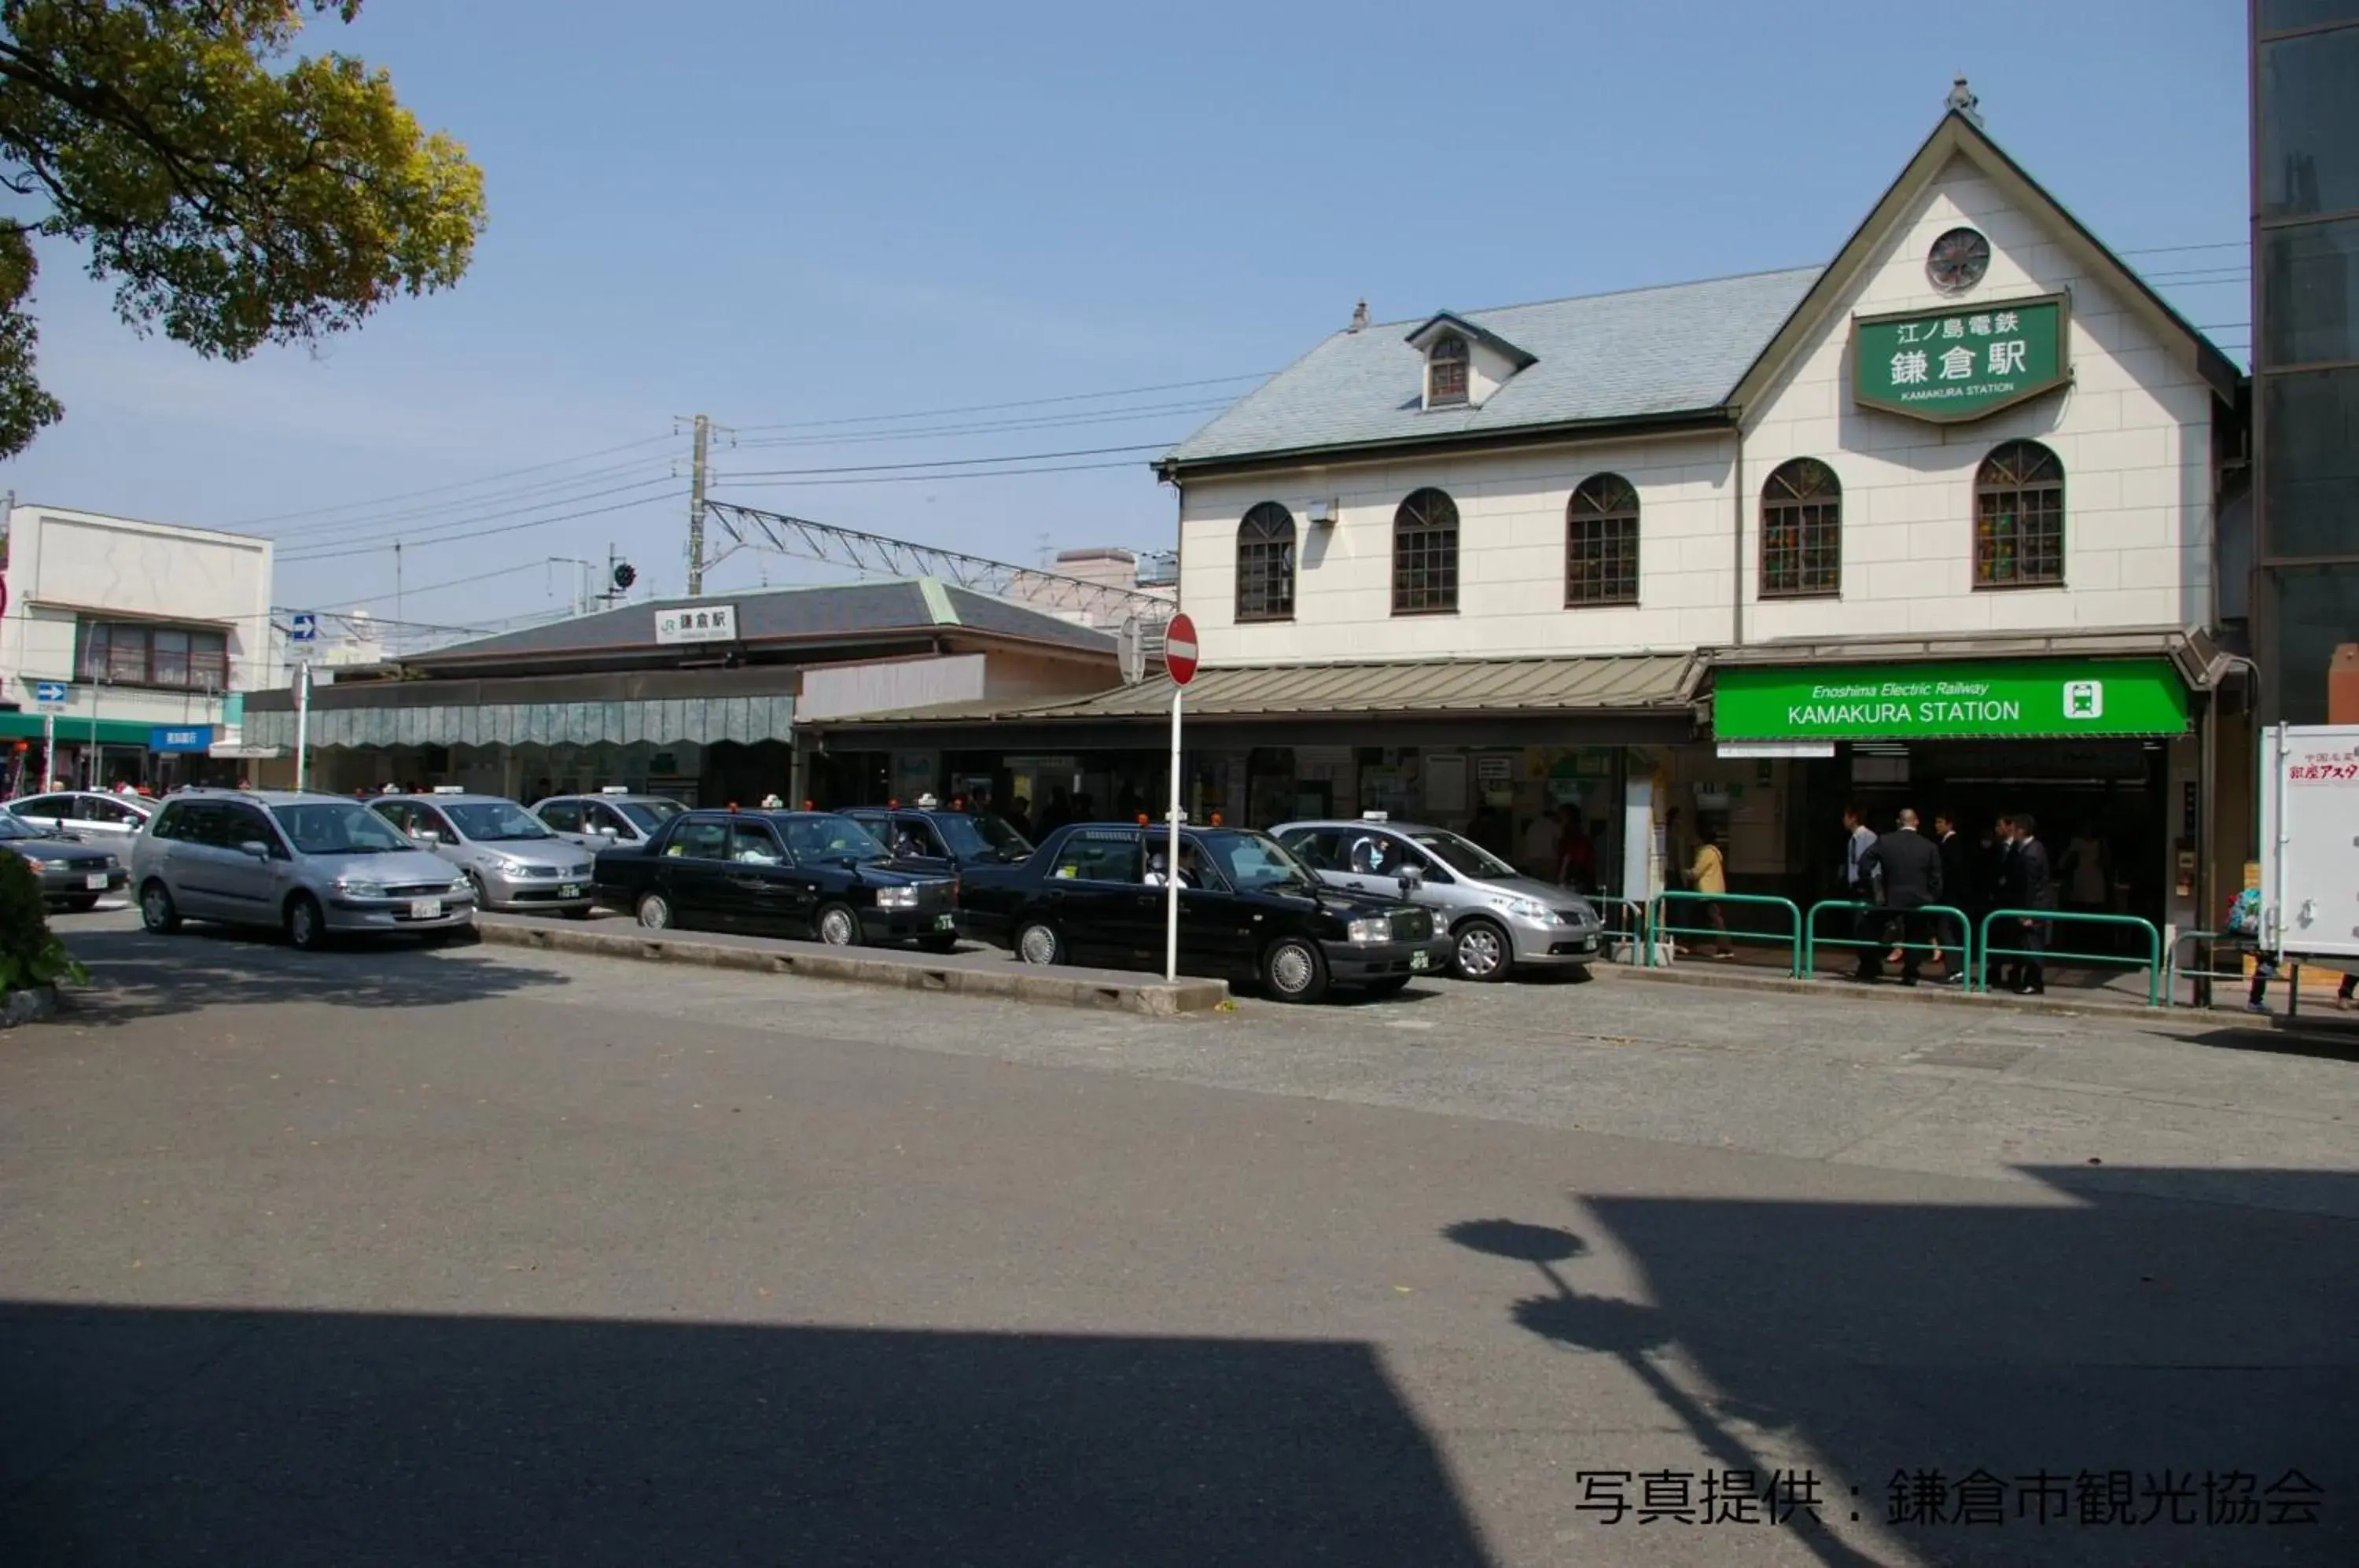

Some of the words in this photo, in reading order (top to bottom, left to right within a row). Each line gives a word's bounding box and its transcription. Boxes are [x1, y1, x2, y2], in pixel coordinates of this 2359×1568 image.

[1897, 311, 2019, 344] 江ノ島電鉄
[1890, 339, 2027, 387] 鎌倉駅
[1901, 388, 1963, 402] KAMAKURA
[1966, 382, 2014, 396] STATION
[1812, 685, 1877, 698] Enoshima
[1881, 683, 1930, 696] Electric
[1935, 682, 1989, 696] Railway
[1788, 703, 1912, 724] KAMAKURA
[1919, 701, 2019, 722] STATION
